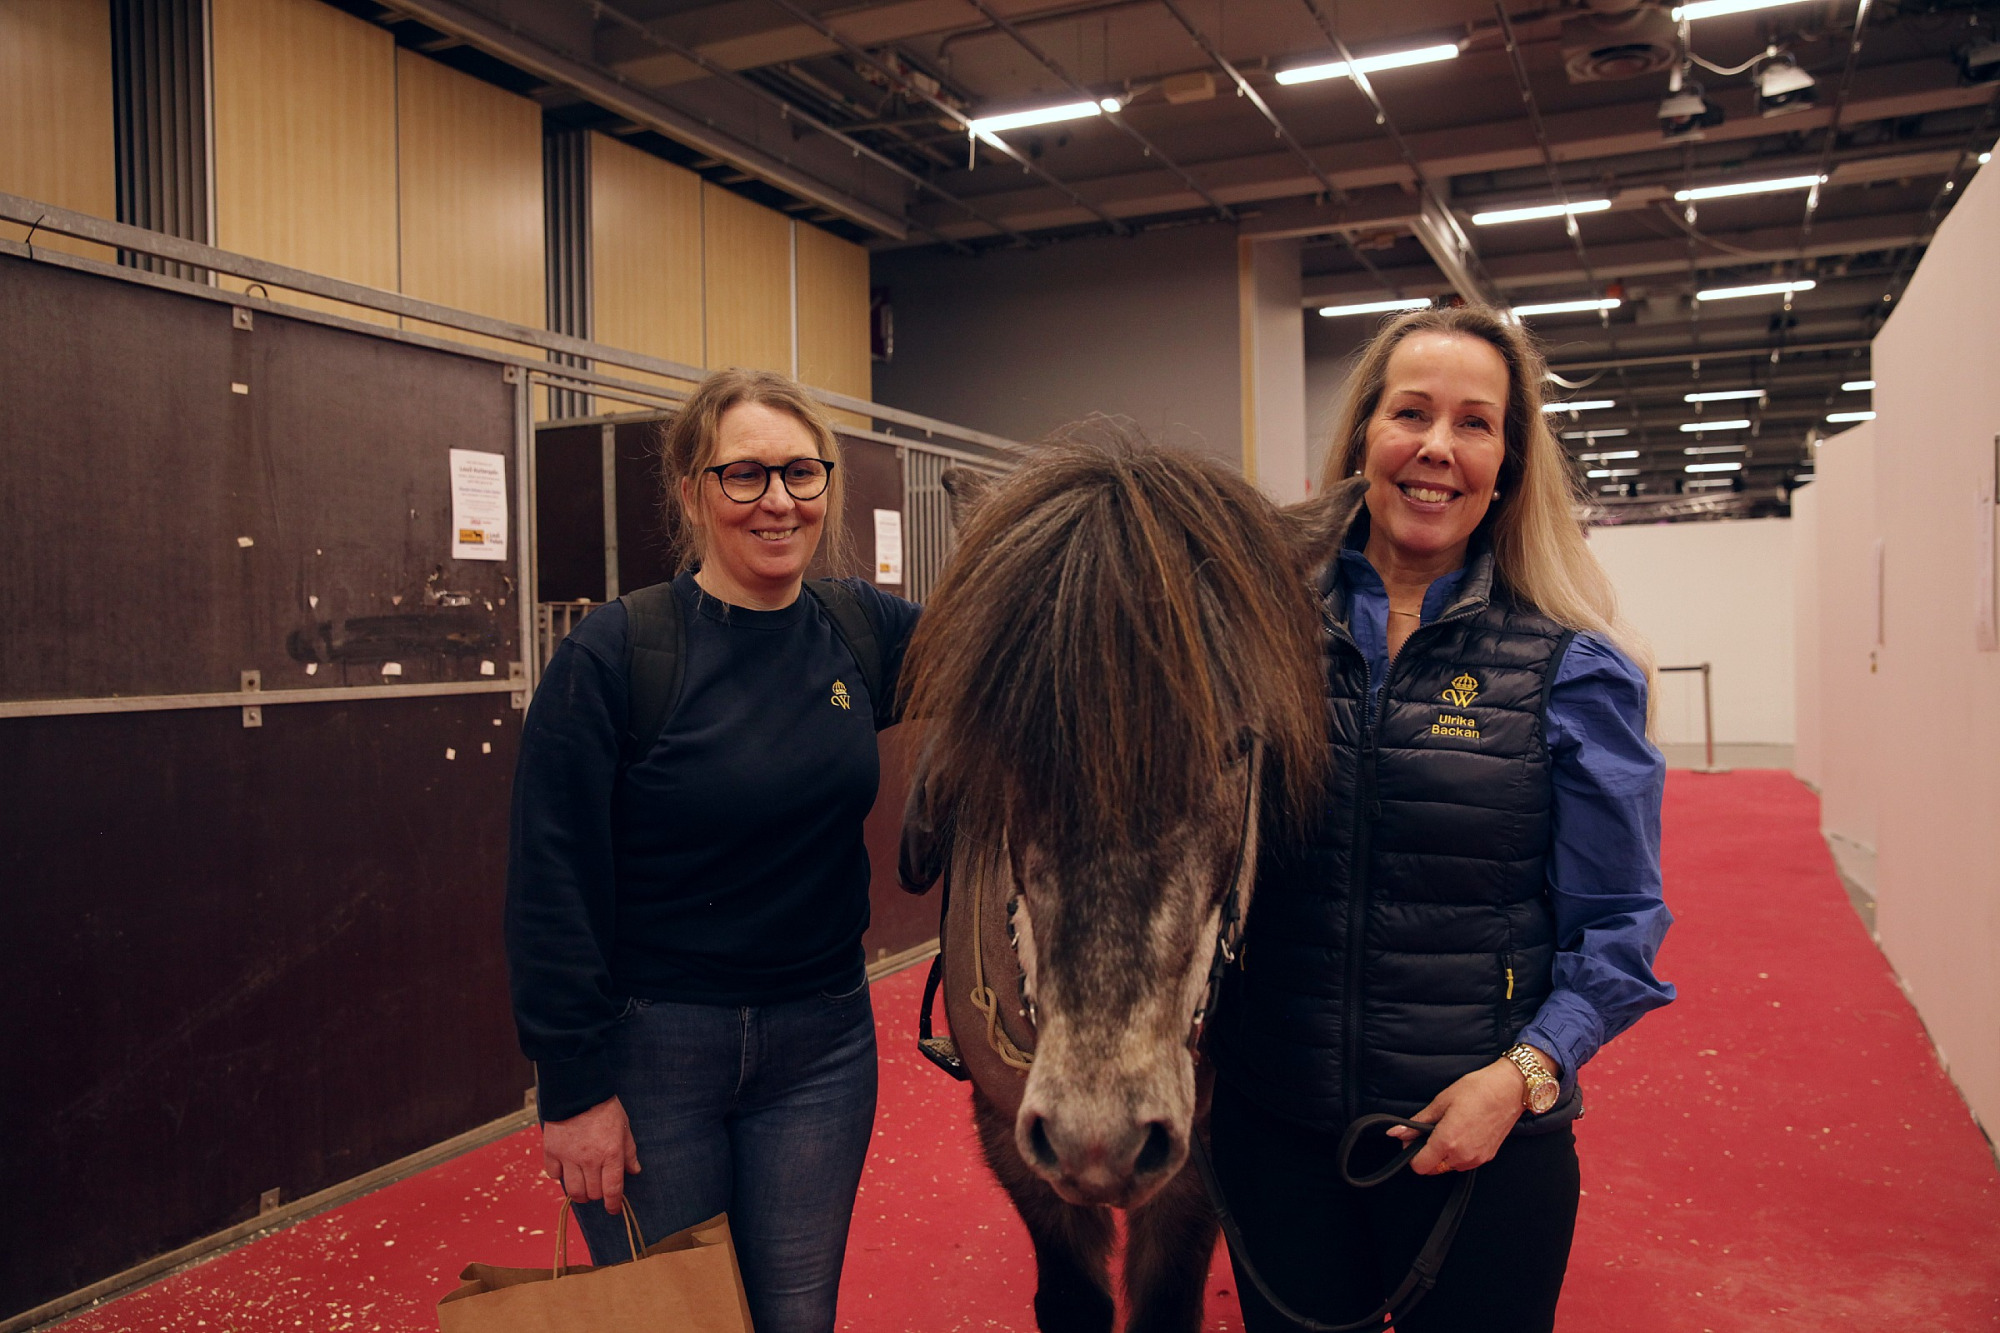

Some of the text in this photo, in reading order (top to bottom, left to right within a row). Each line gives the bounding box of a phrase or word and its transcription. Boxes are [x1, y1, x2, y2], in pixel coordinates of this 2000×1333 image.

[1442, 689, 1479, 708] W
[1439, 714, 1475, 727] Ulrika
[1431, 724, 1480, 739] Backan
